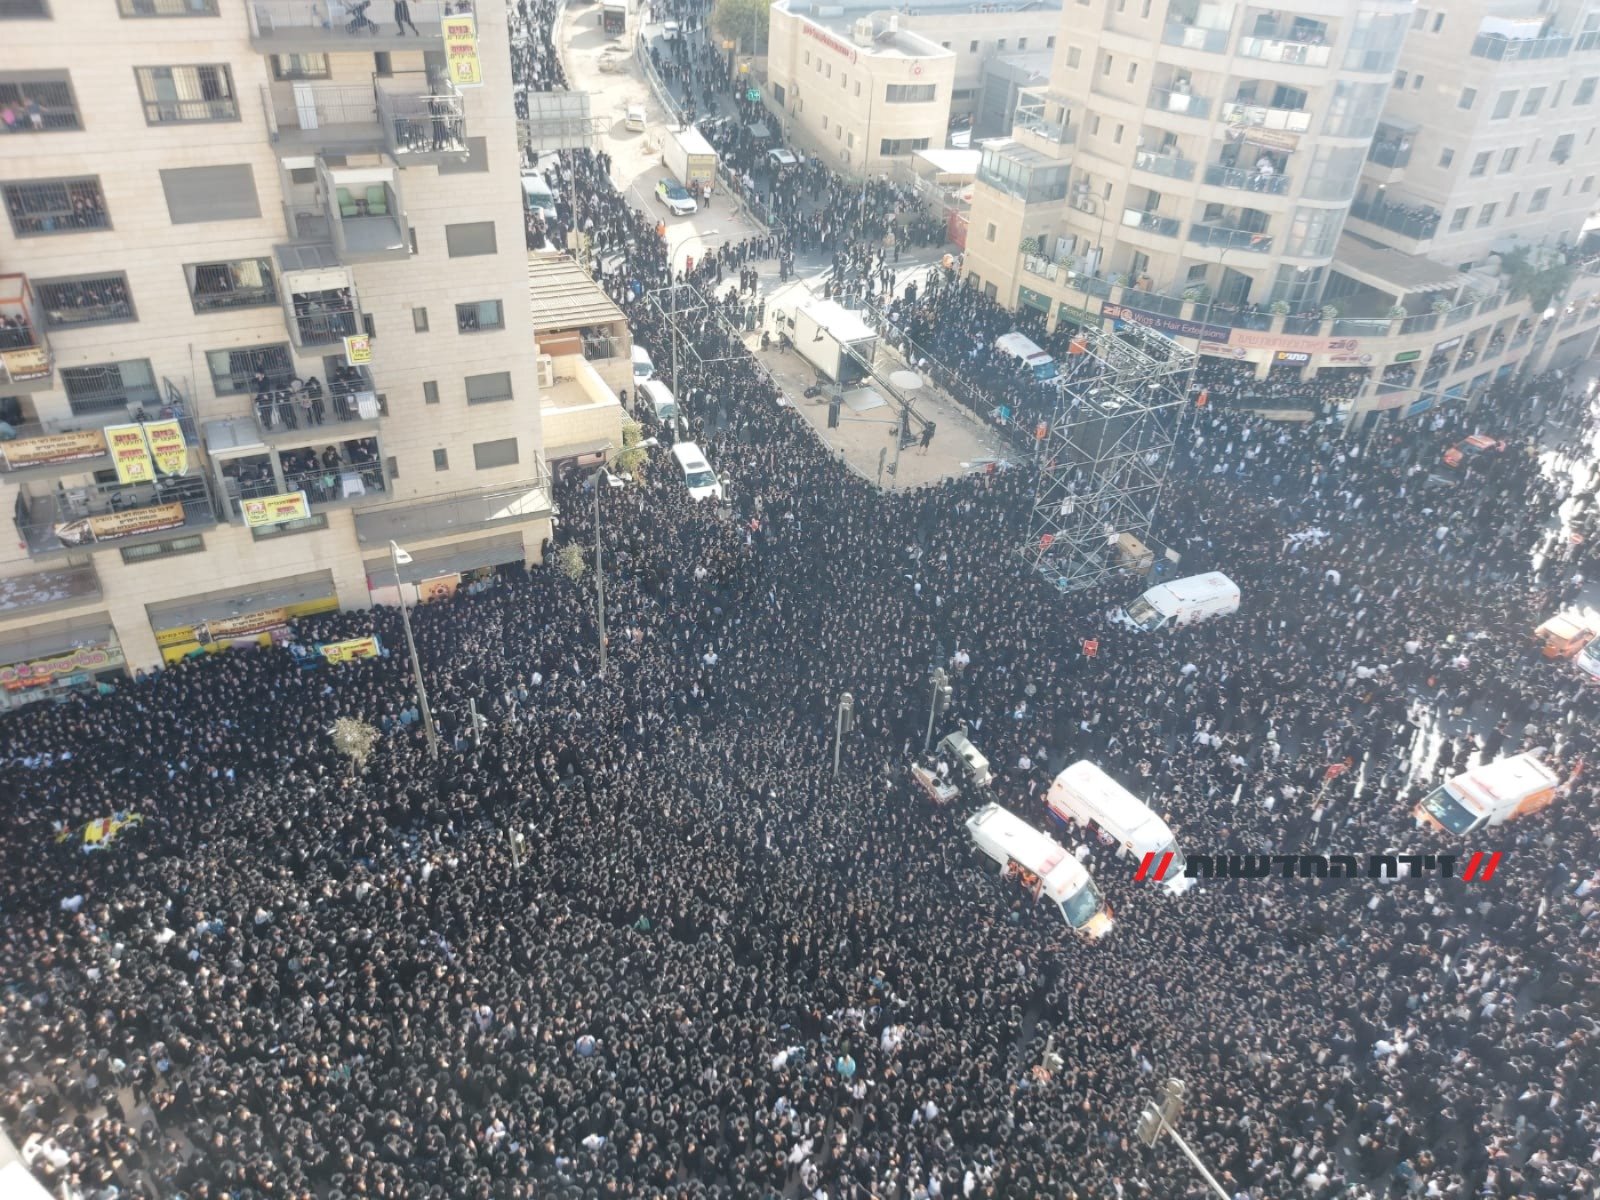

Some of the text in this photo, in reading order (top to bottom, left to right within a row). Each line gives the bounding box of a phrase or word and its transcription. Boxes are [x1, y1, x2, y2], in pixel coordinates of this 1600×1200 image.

[1134, 313, 1154, 327] Wigs
[1155, 318, 1161, 327] &
[1163, 320, 1182, 331] Hair
